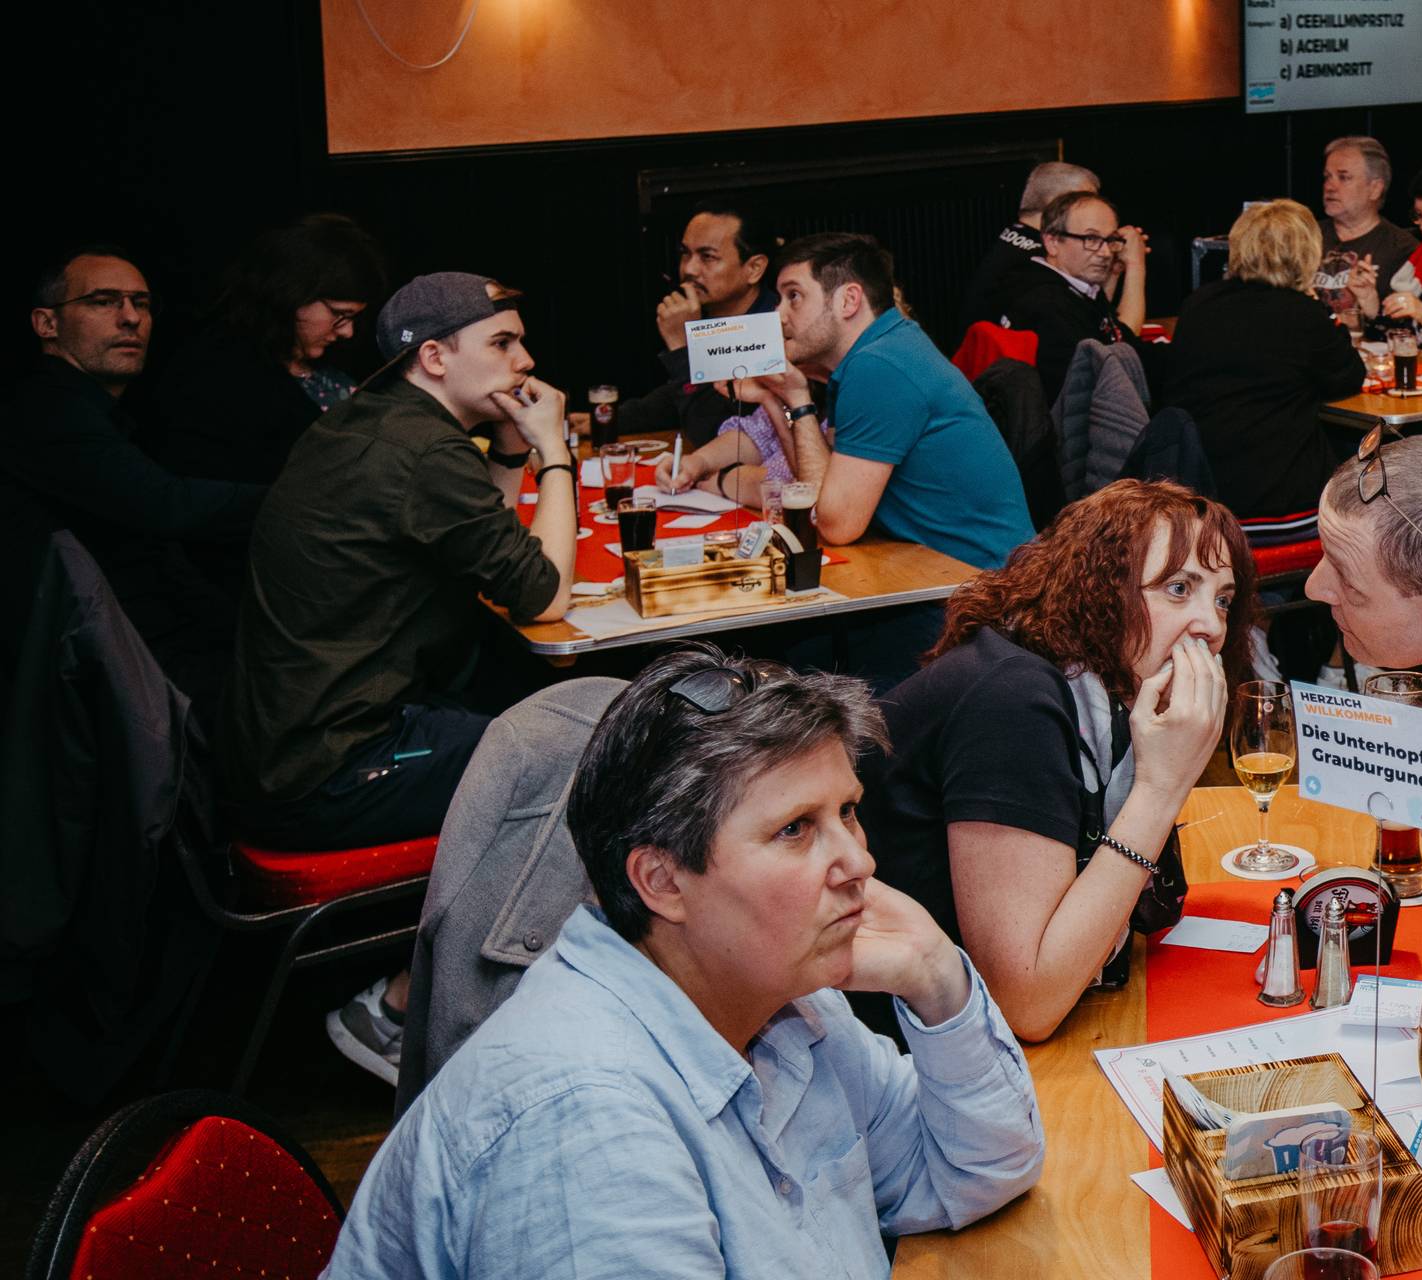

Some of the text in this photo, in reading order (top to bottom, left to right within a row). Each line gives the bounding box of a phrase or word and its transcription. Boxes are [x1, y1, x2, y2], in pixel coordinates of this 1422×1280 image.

[1280, 14, 1292, 31] a)
[1280, 38, 1349, 56] b) ACEHILM
[1280, 61, 1373, 81] c) AEIMNORRTT
[691, 321, 727, 332] HERZLICH
[707, 342, 766, 356] Wild-Kader
[1300, 691, 1362, 709] HERZLICH
[1304, 703, 1393, 726] WILLKOMMEN
[1302, 723, 1330, 742] Die
